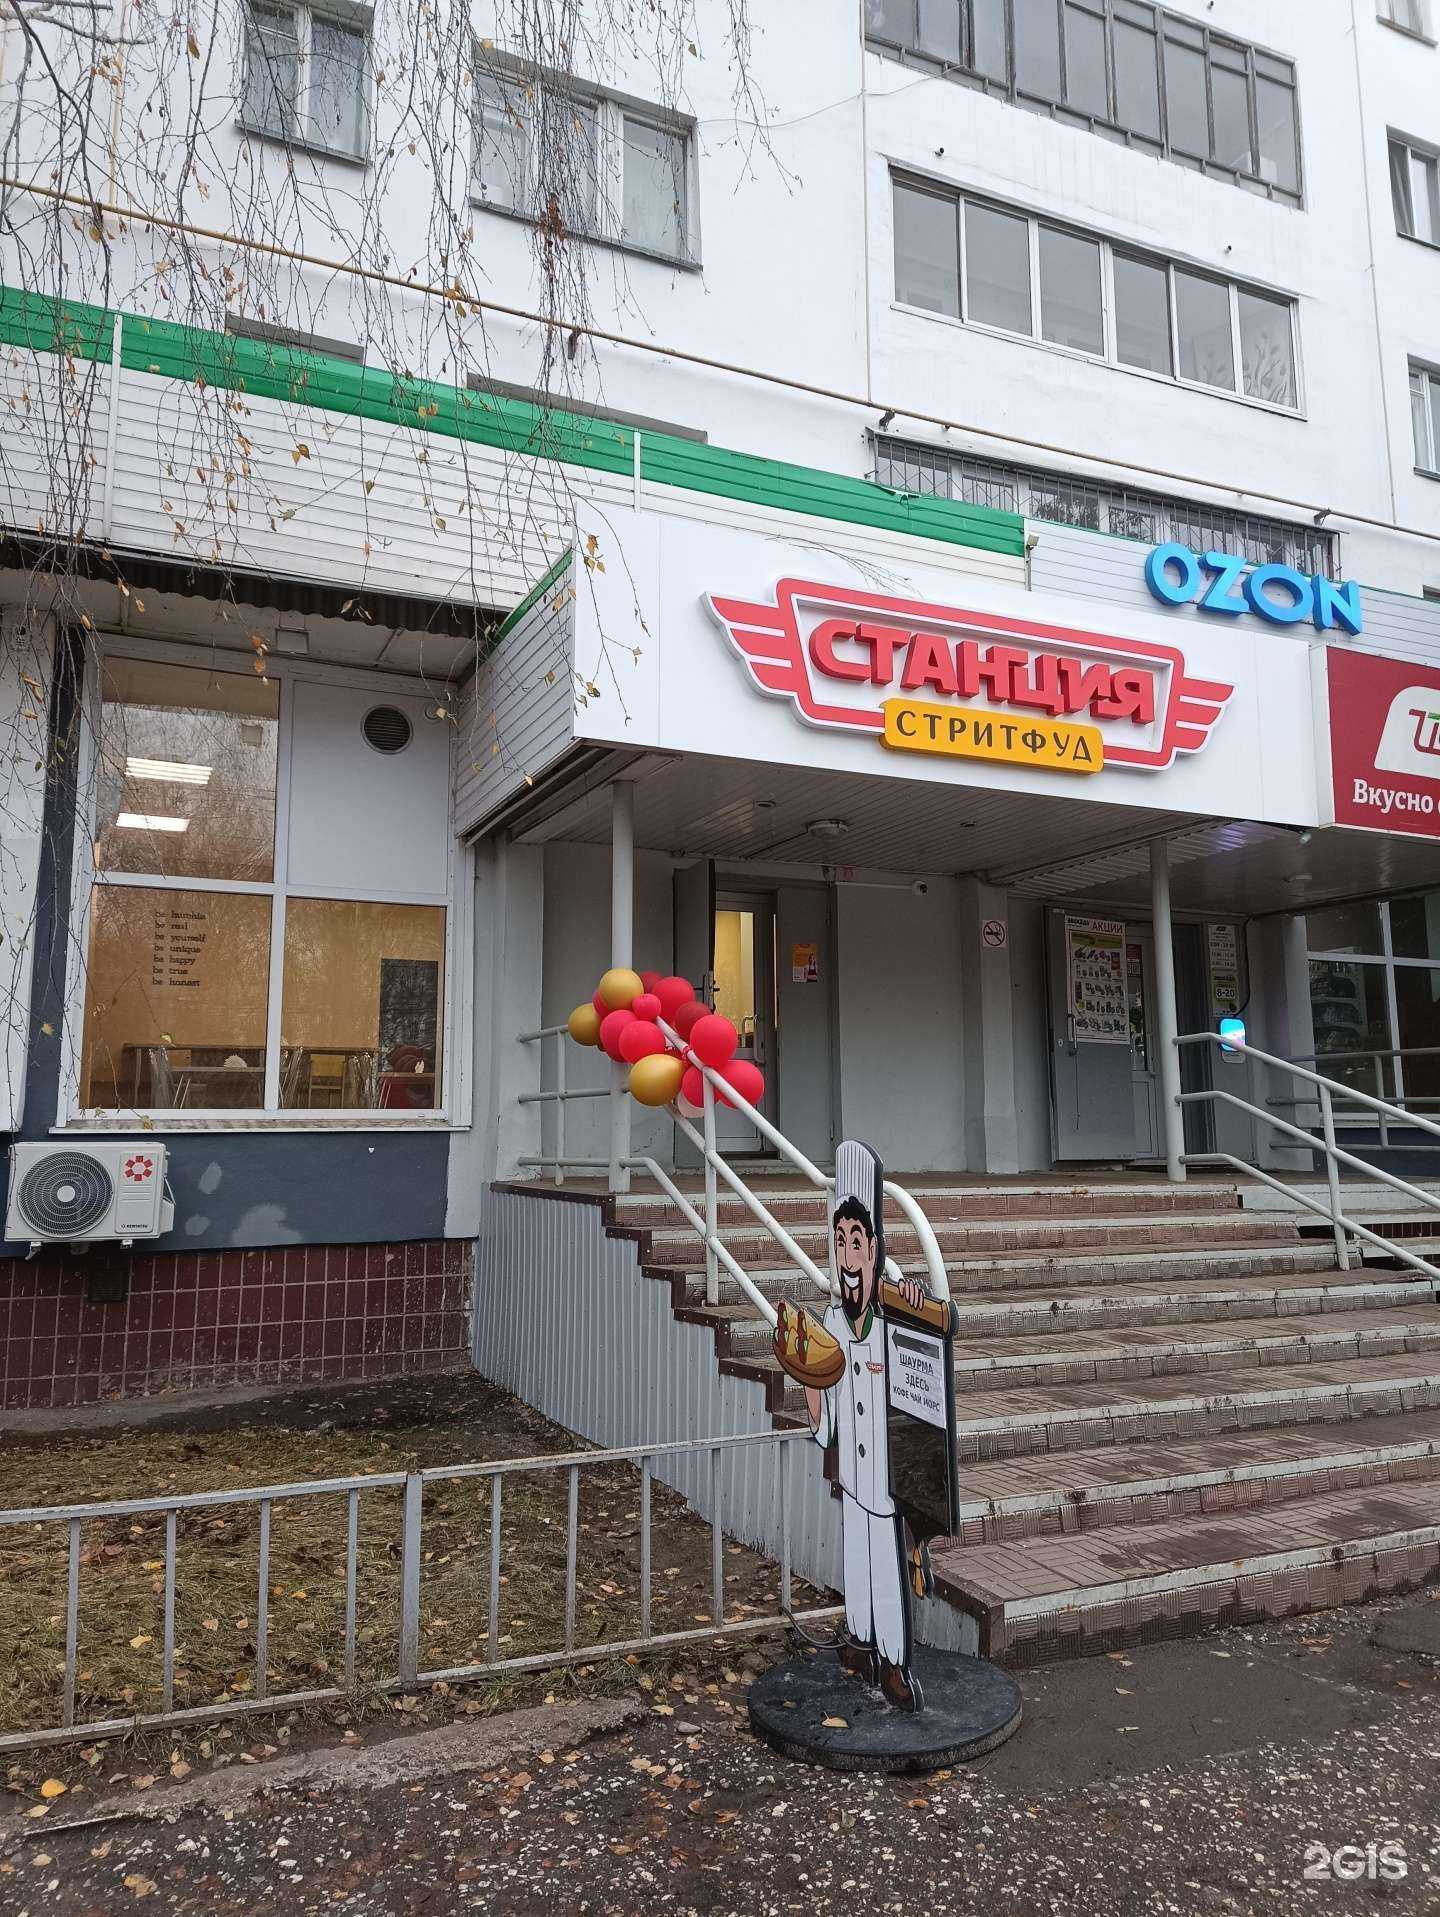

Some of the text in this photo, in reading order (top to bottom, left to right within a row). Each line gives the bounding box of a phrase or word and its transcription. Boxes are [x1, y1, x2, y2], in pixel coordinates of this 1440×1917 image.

[1144, 542, 1363, 636] OZON
[808, 618, 1156, 725] СТАНЦИЯ
[896, 709, 1092, 764] СТРИТФУД
[1352, 778, 1434, 814] Вкусно
[1092, 921, 1123, 934] АКЦИИ
[169, 945, 201, 954] unique
[169, 955, 196, 966] happy
[899, 1352, 934, 1376] ШАУРМА
[905, 1373, 930, 1392] ЗДЕСЬ
[892, 1385, 909, 1399] КОФЕ
[923, 1396, 940, 1412] МОРС
